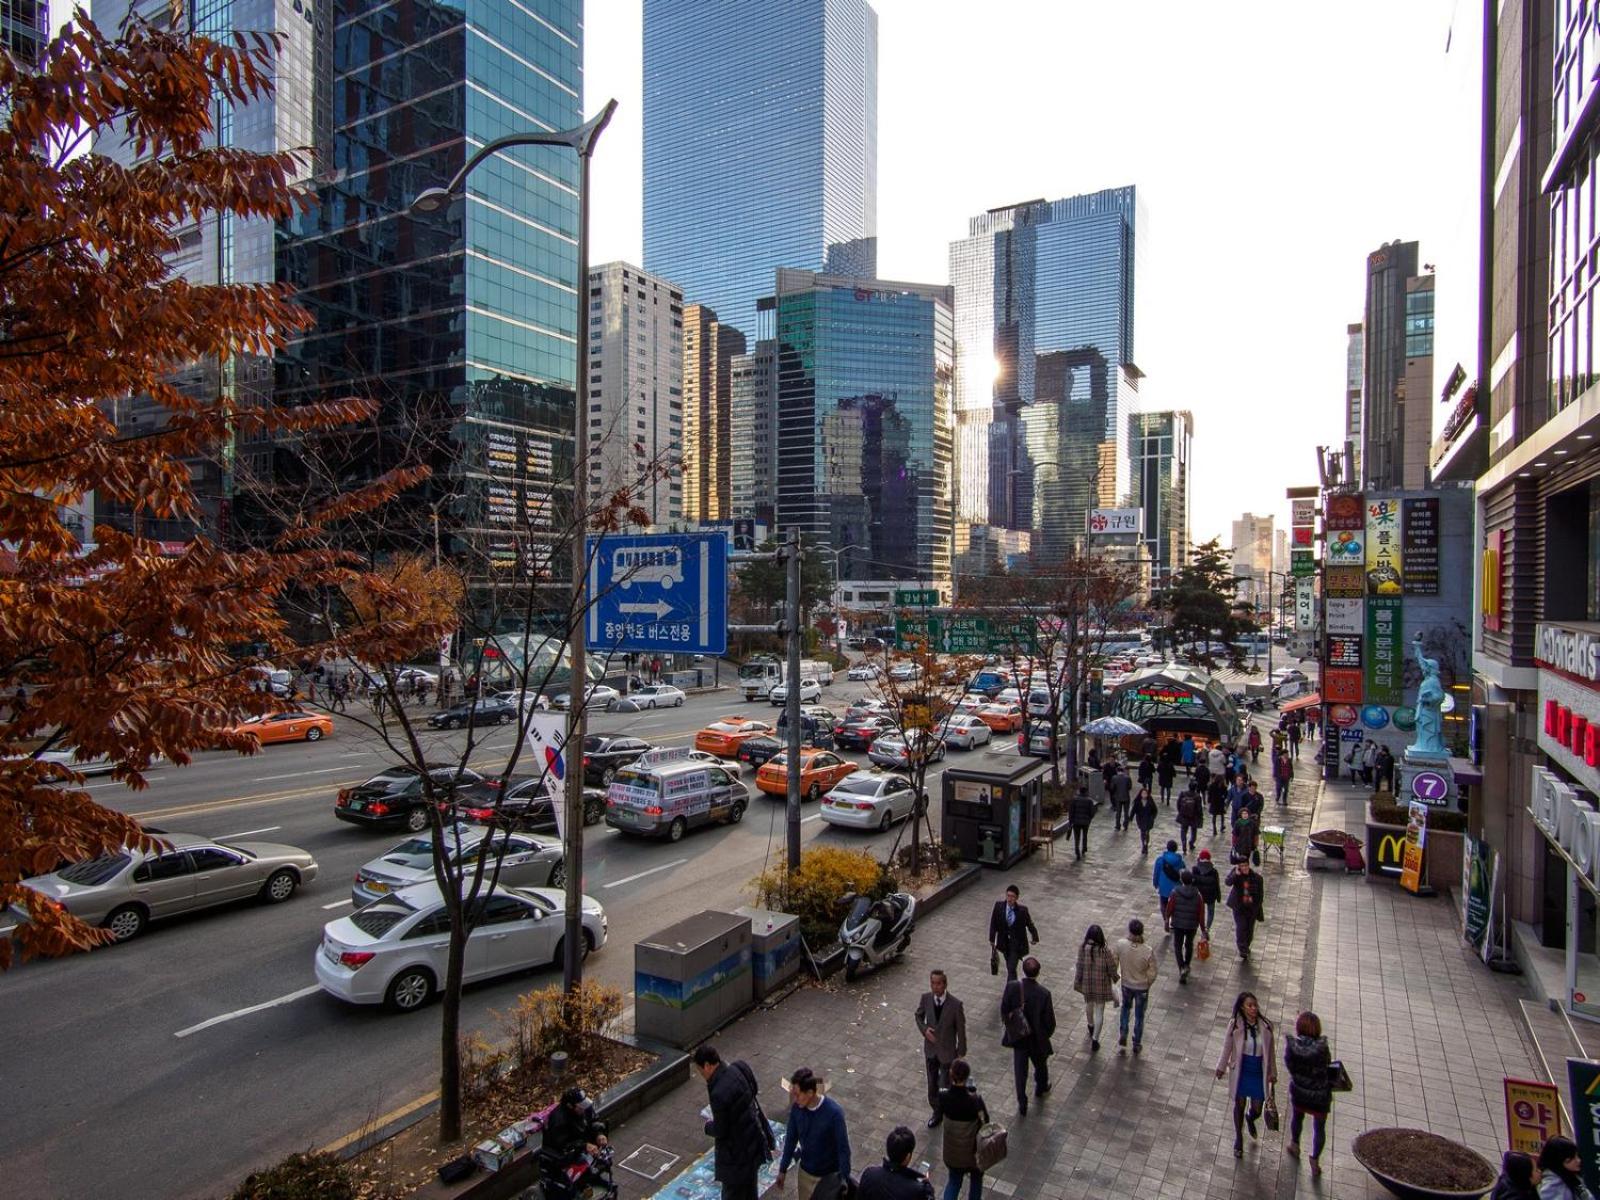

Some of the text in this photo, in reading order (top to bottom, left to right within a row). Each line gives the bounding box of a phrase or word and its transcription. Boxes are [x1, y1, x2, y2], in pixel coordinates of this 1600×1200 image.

[1111, 515, 1135, 528] 큐원
[1376, 530, 1392, 575] 플스방
[1329, 575, 1361, 588] 부동산
[648, 623, 691, 641] 버스전용
[1535, 624, 1596, 681] McDonald's
[1422, 778, 1437, 796] 7
[1513, 1100, 1553, 1142] 약
